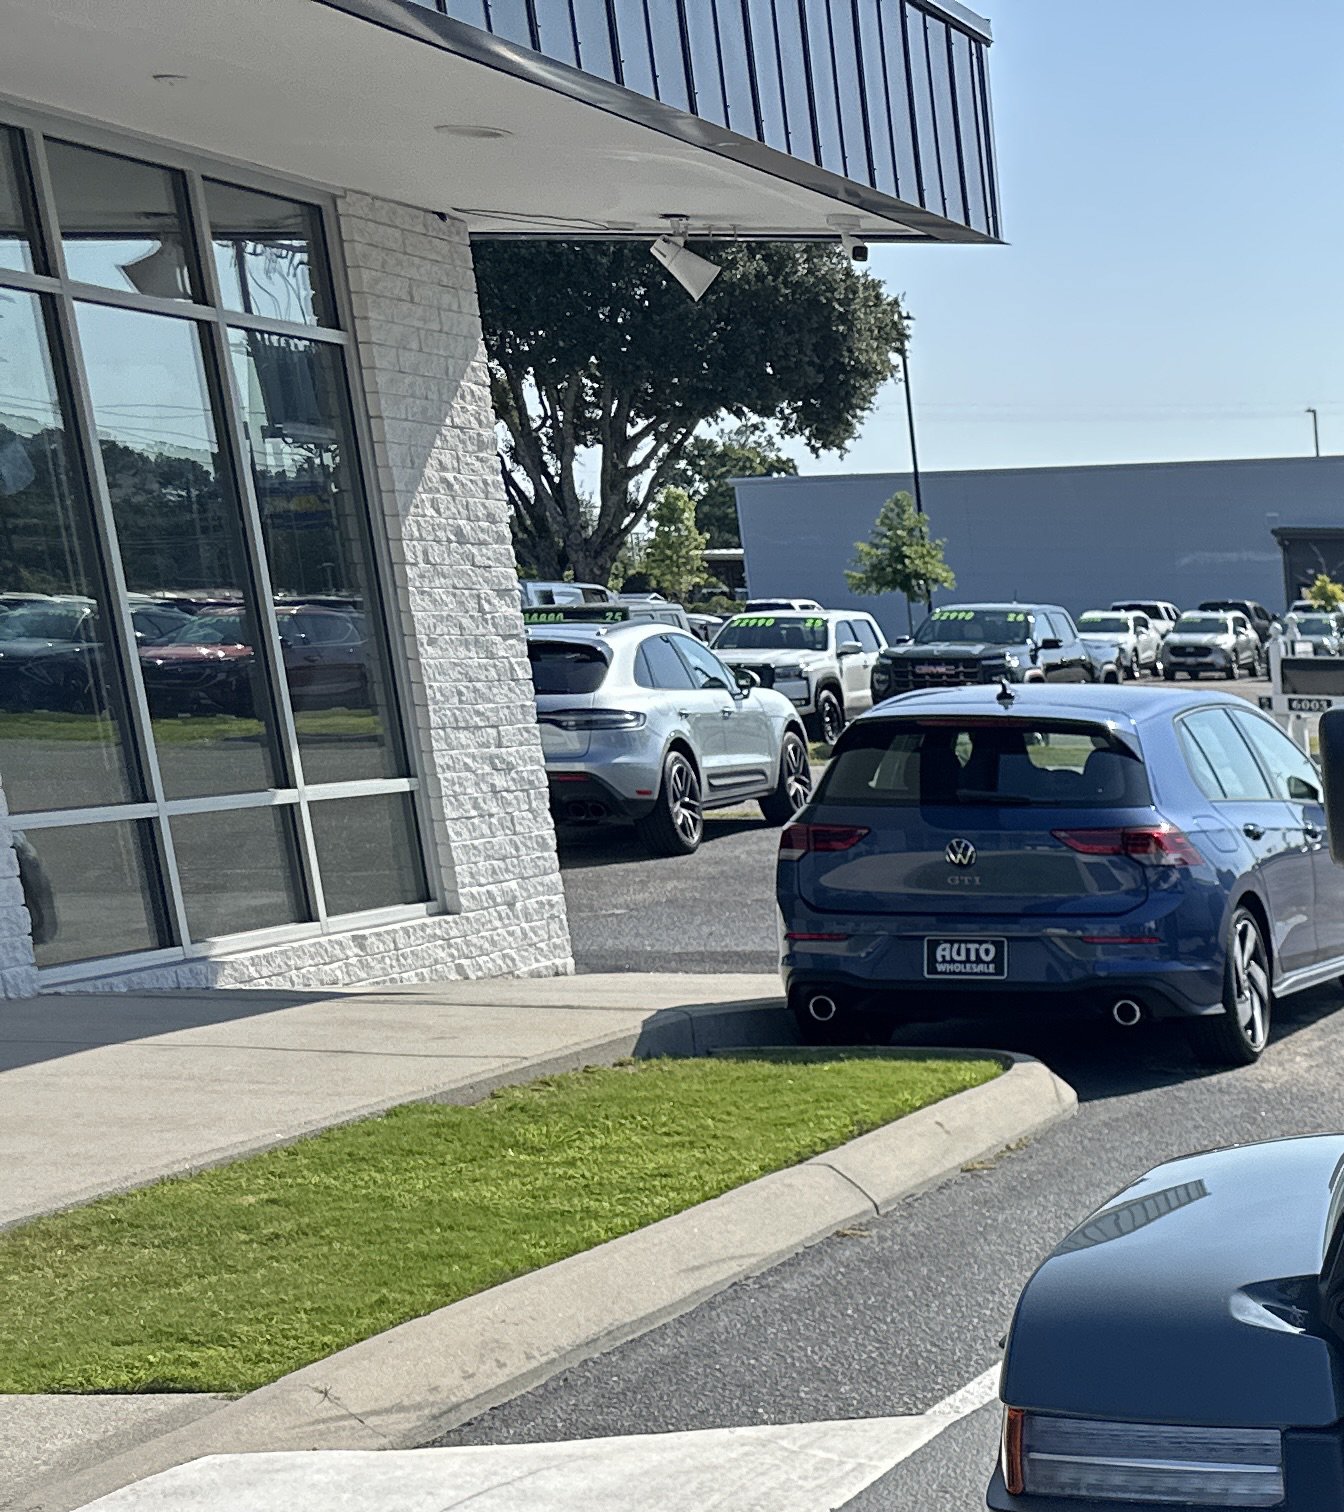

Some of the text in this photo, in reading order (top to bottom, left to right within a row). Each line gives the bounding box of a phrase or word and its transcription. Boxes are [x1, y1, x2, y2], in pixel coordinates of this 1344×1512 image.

[1291, 699, 1329, 711] 6003
[947, 875, 982, 886] GTI
[935, 942, 997, 963] AUTO
[935, 962, 996, 973] WHOLESALE
